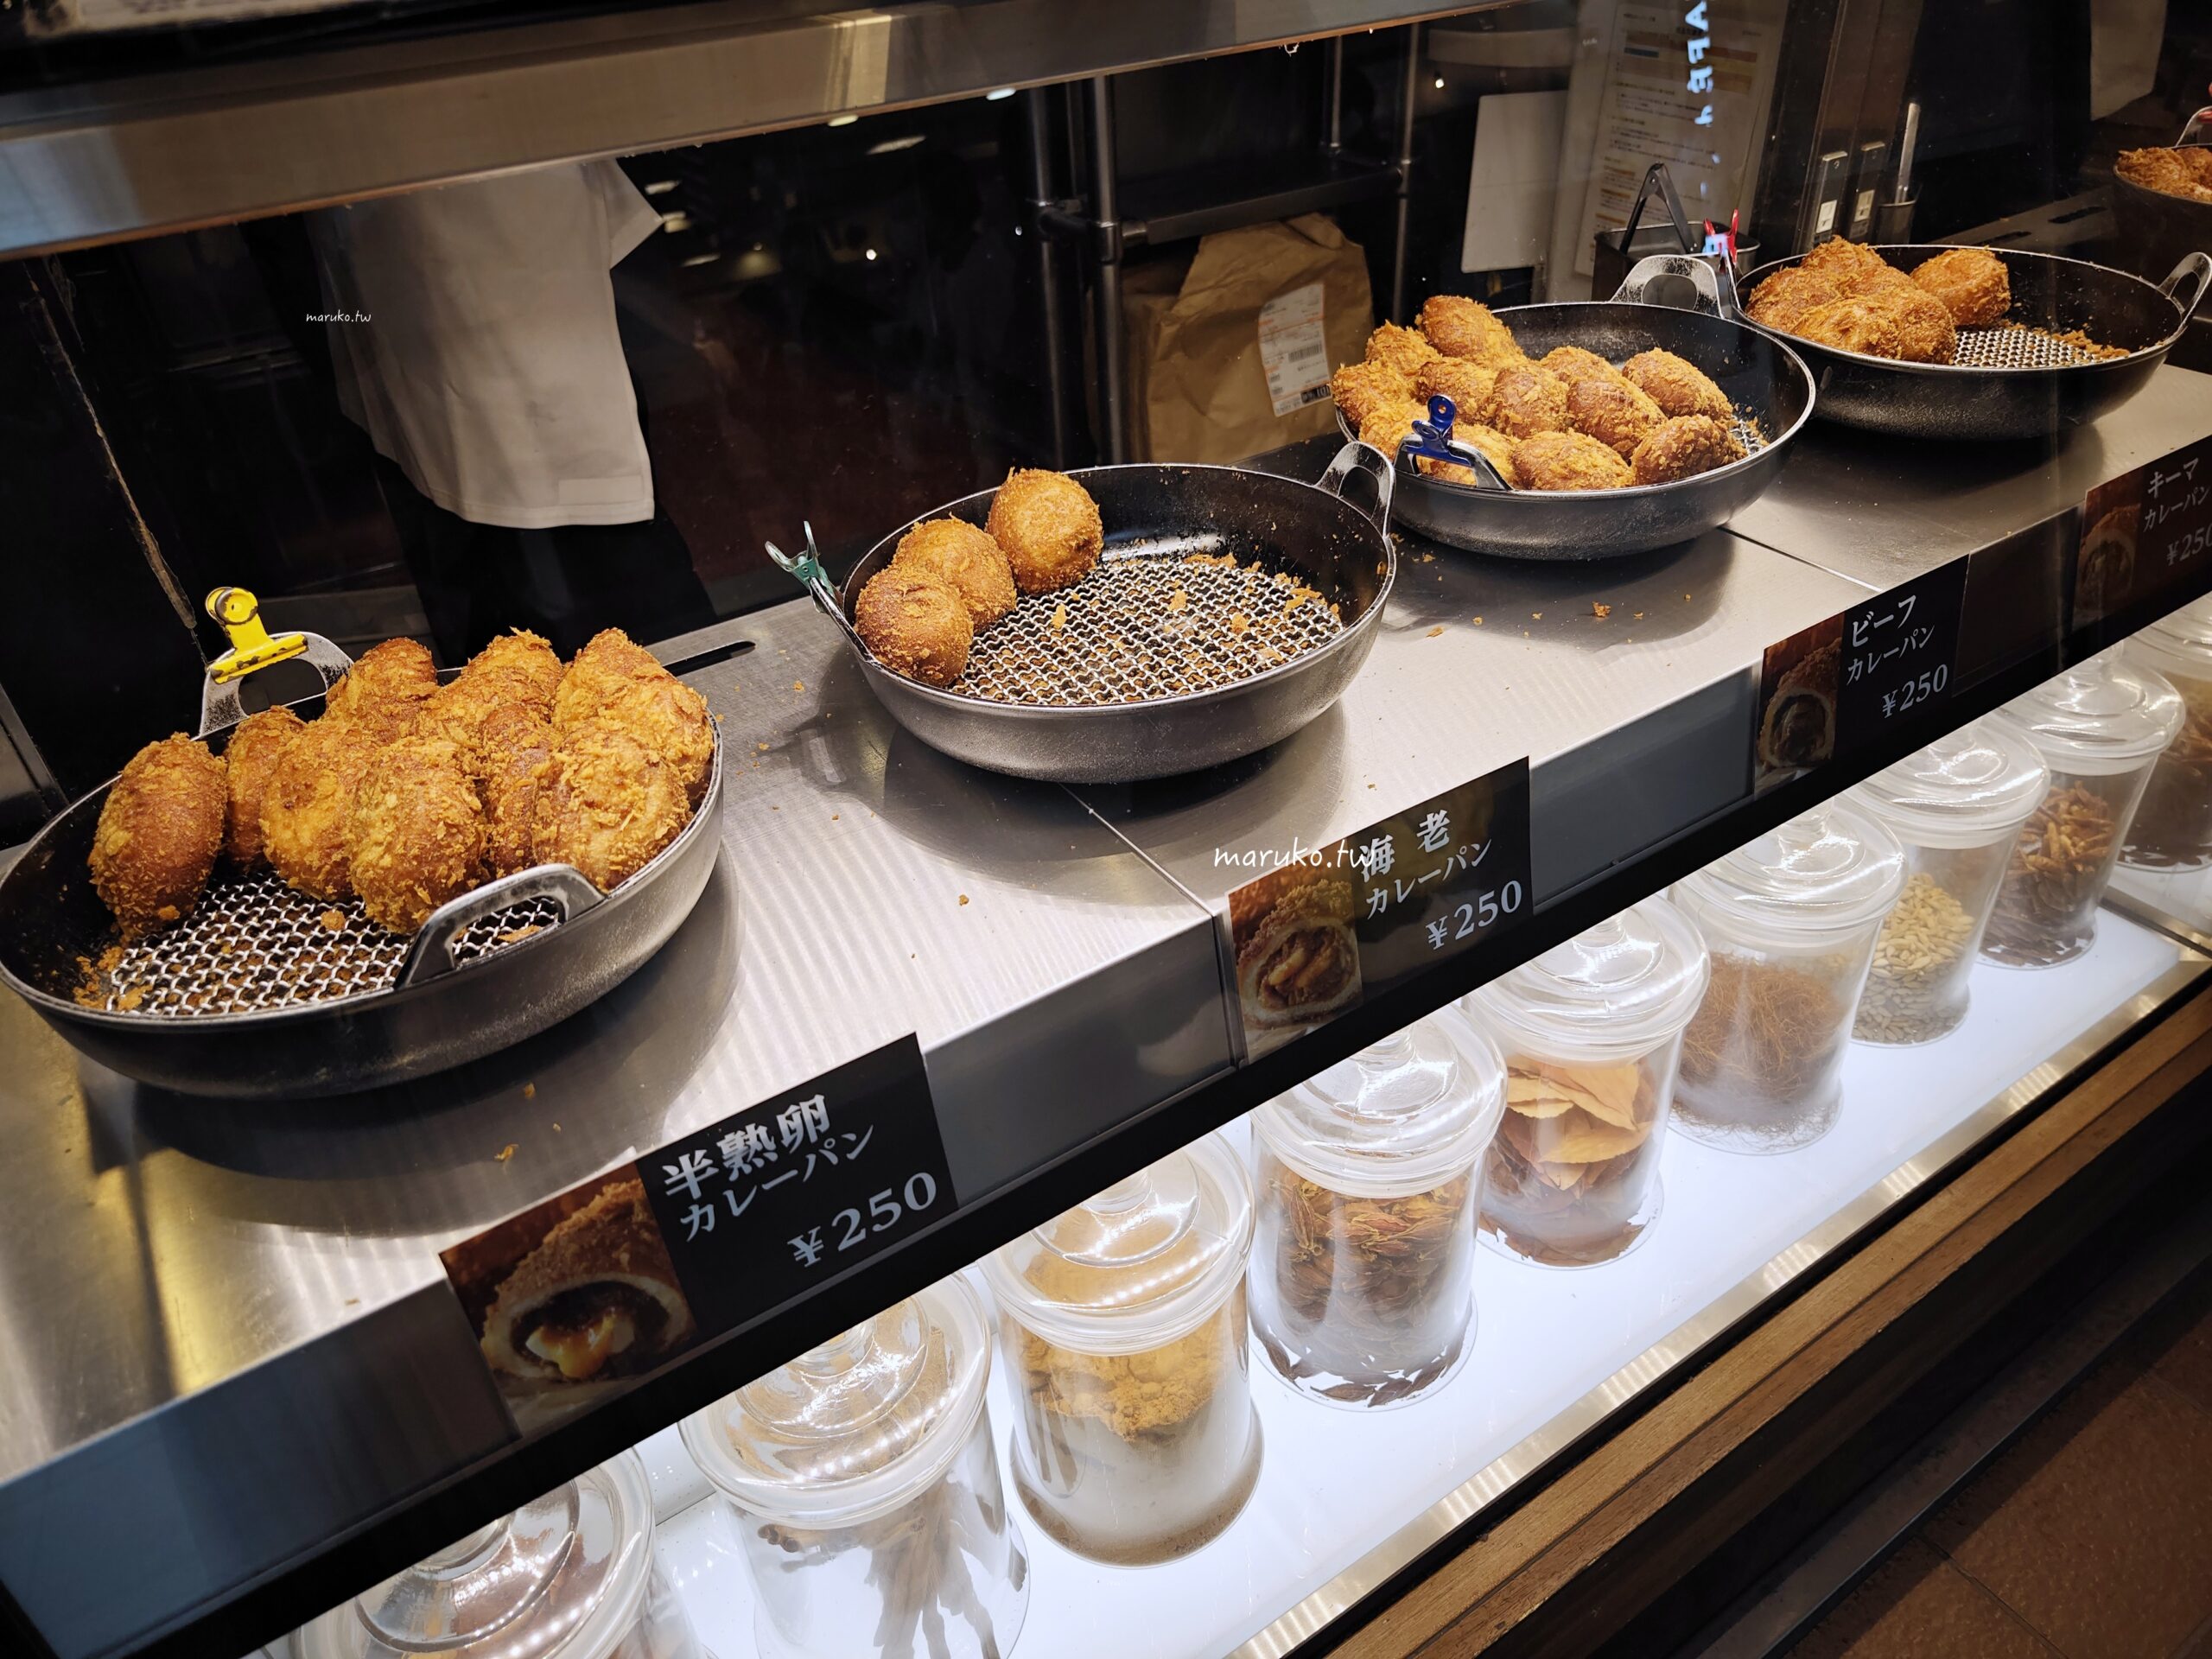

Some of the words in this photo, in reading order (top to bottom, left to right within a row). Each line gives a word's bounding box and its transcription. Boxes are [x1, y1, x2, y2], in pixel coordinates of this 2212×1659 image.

[2143, 486, 2211, 532] カレーパン
[2147, 457, 2199, 499] キーマ
[1852, 594, 1916, 647] ビーフ
[1847, 625, 1936, 685] カレーパン
[1881, 664, 1948, 719] ¥250
[1366, 839, 1492, 920] カレーパン
[1425, 880, 1522, 951] ¥250
[662, 1094, 830, 1200] 半熟卵
[680, 1124, 874, 1242] カレーパン
[787, 1172, 937, 1268] ¥250
